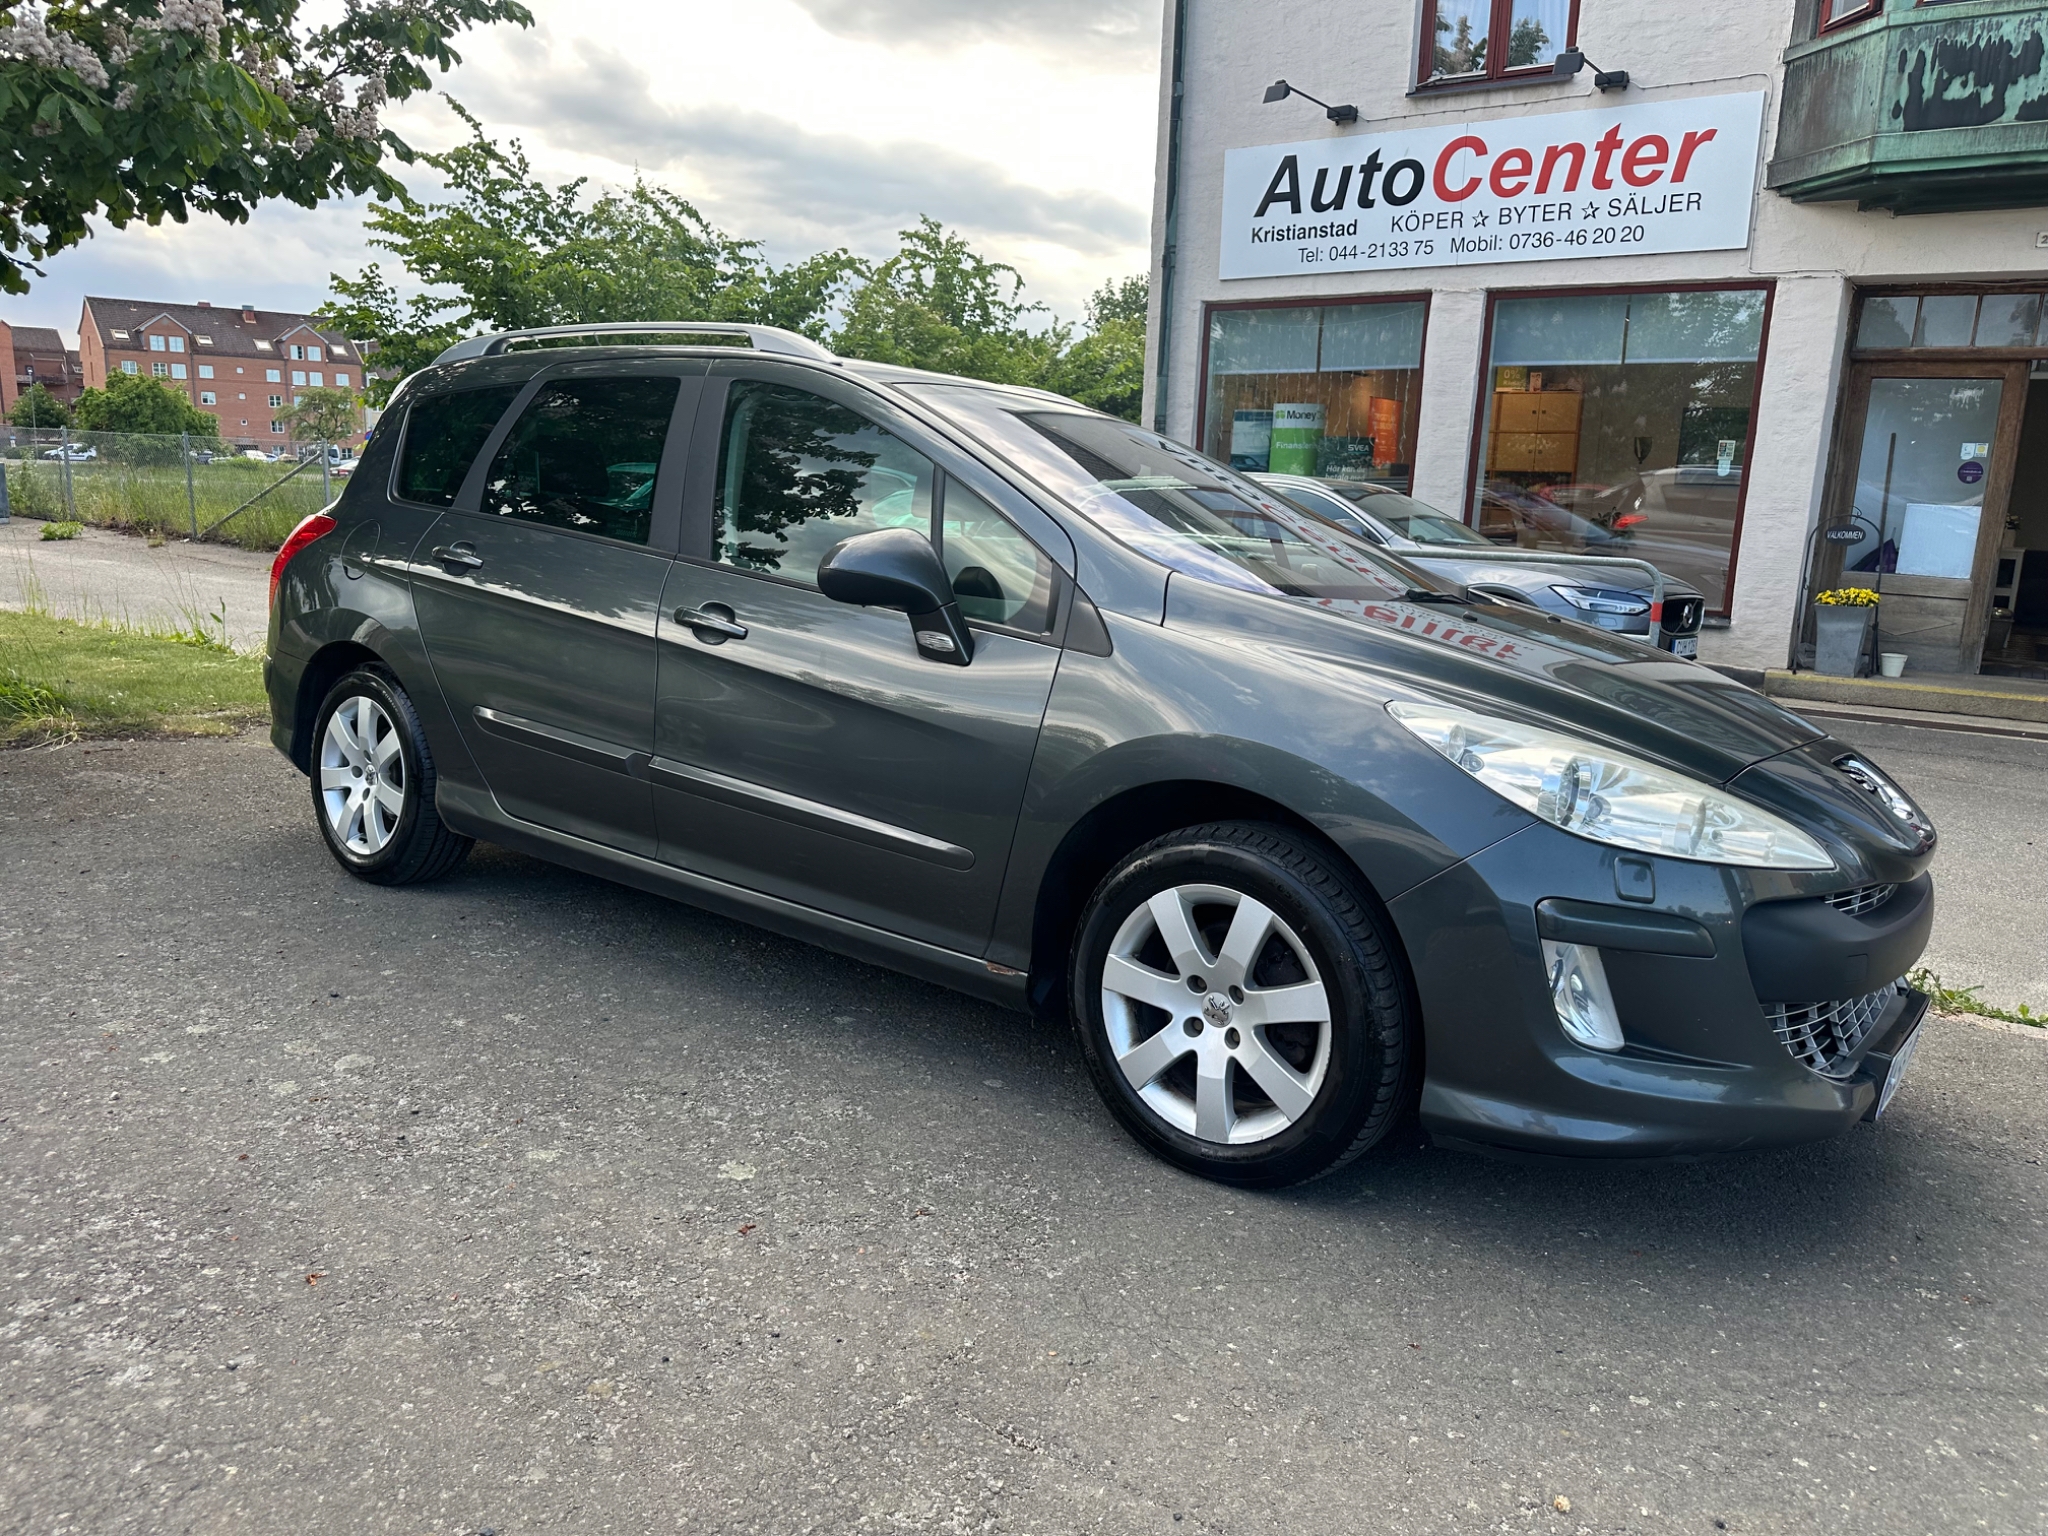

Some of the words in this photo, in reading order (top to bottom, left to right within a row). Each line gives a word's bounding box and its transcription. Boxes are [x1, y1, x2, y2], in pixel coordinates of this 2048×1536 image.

[1391, 209, 1464, 233] KÖPER
[1498, 202, 1572, 226] BYTER
[1607, 192, 1702, 218] SÄLJER
[1251, 218, 1358, 244] Kristianstad
[1298, 247, 1324, 263] Tel:
[1450, 234, 1502, 254] Mobil:
[1347, 444, 1370, 452] SVEA
